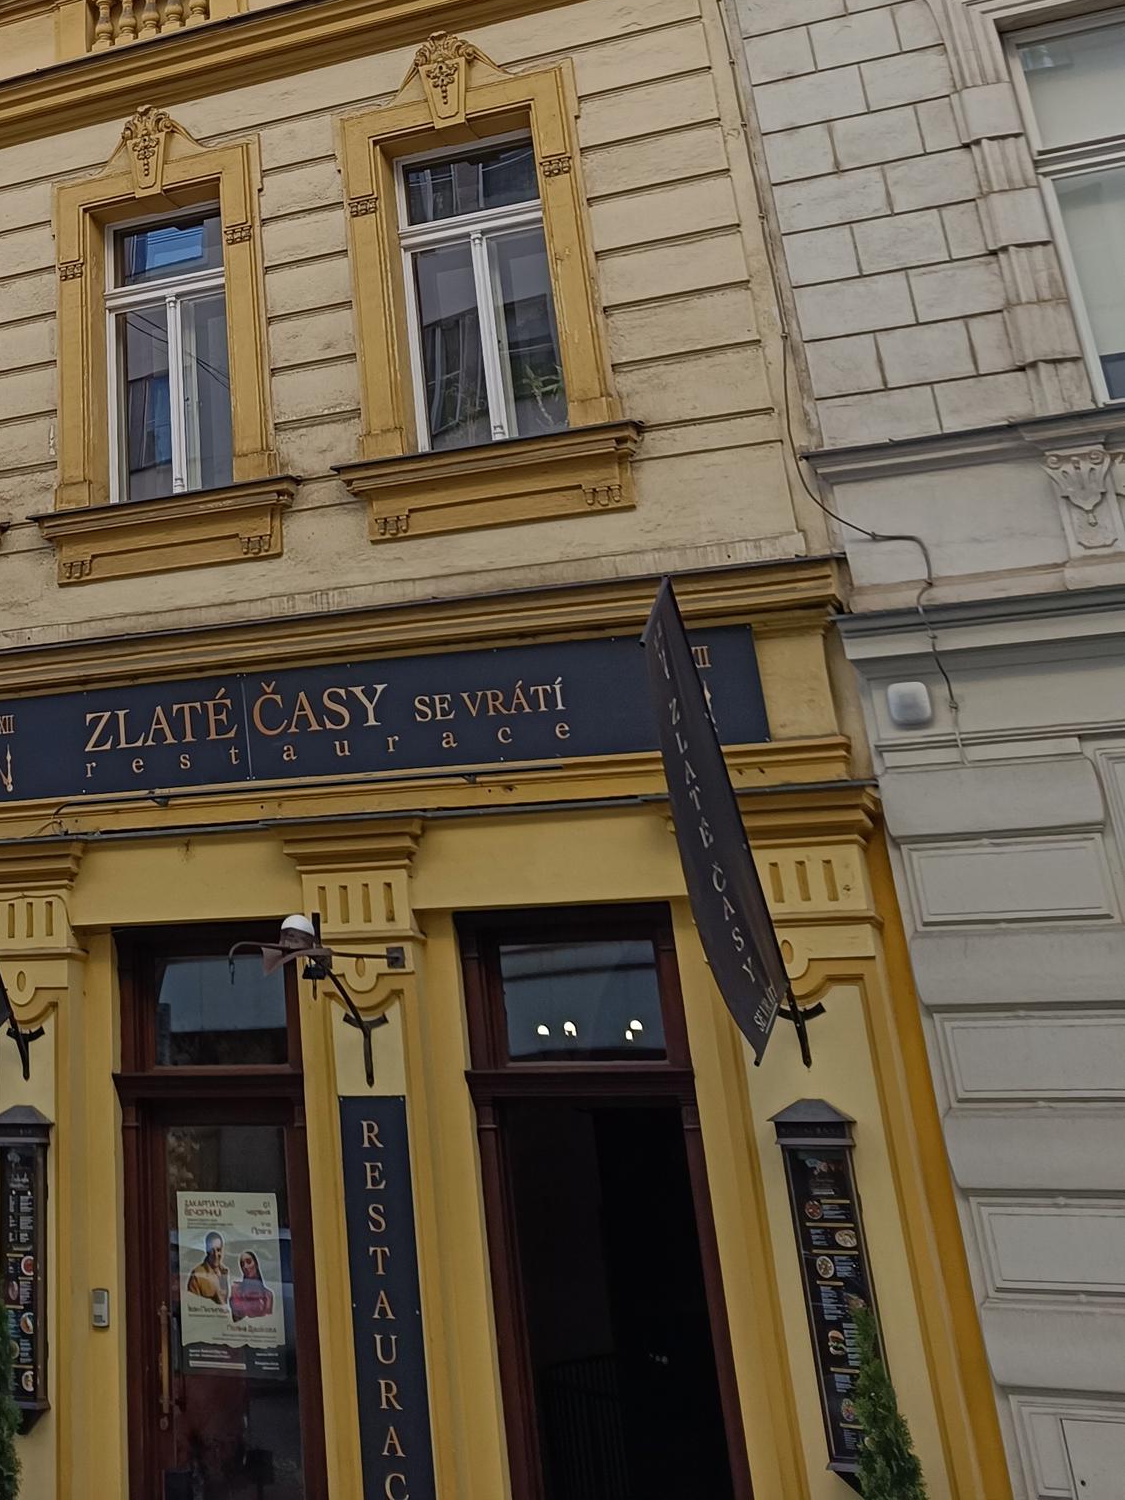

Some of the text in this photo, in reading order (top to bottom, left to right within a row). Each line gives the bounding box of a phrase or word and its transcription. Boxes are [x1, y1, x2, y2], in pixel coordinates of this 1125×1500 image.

[83, 676, 567, 753] ZLATÉ ČASY SE VRÁTÍ
[85, 722, 570, 778] restaurace
